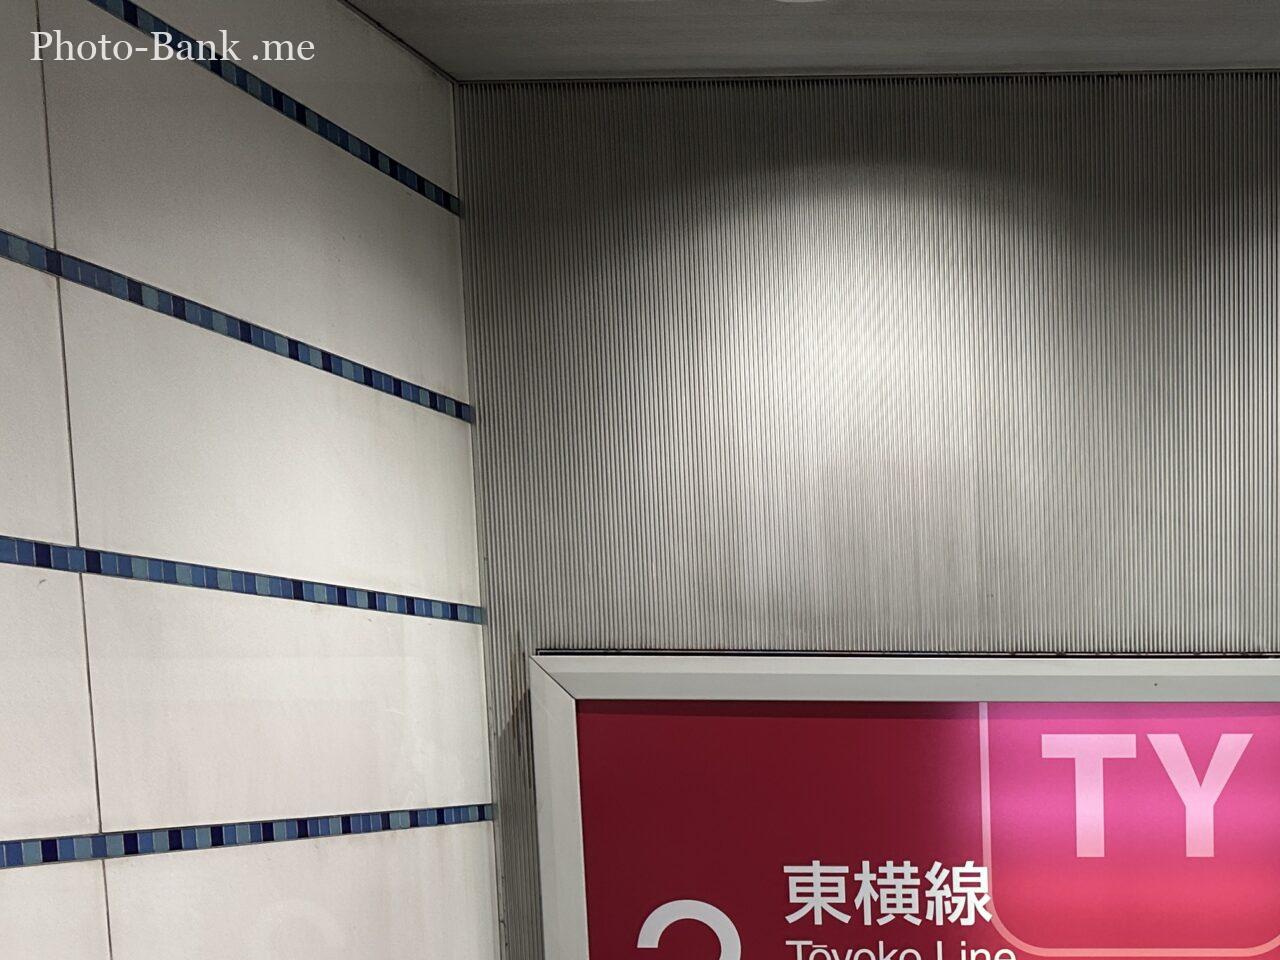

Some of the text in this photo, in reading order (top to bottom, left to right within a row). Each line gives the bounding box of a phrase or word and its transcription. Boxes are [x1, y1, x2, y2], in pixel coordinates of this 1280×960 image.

[1041, 733, 1254, 858] TY
[783, 860, 993, 926] 東横線
